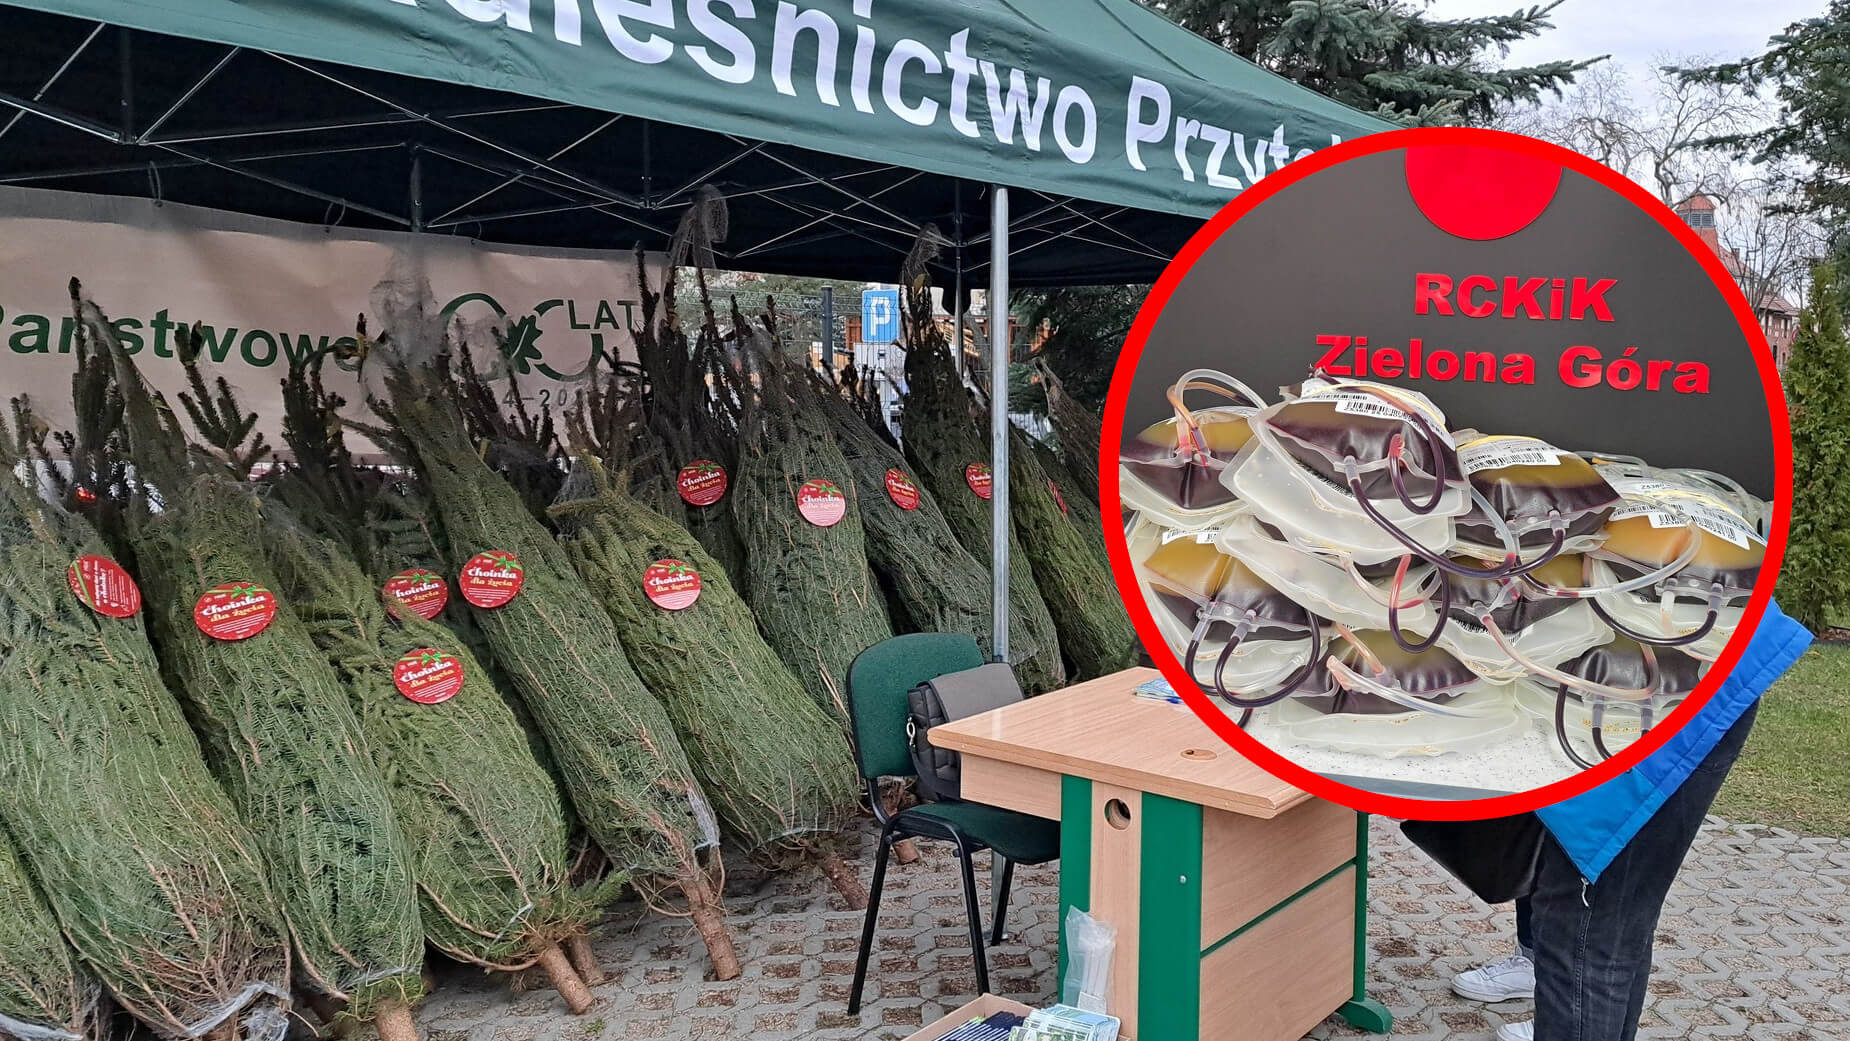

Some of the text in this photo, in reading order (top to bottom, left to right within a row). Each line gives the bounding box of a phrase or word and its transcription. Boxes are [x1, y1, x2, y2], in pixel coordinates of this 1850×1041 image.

[1414, 272, 1618, 322] RCKiK
[567, 299, 638, 330] LAT
[870, 296, 891, 337] P
[1313, 334, 1711, 394] Zielona Góra
[682, 472, 721, 487] Choinka
[802, 494, 841, 503] Choinka
[468, 566, 517, 579] Choinka
[649, 573, 695, 586] Choinka
[392, 583, 440, 598] hoinka
[202, 595, 266, 616] Choinka
[210, 604, 265, 622] dla życia
[400, 661, 453, 683] Choinka
